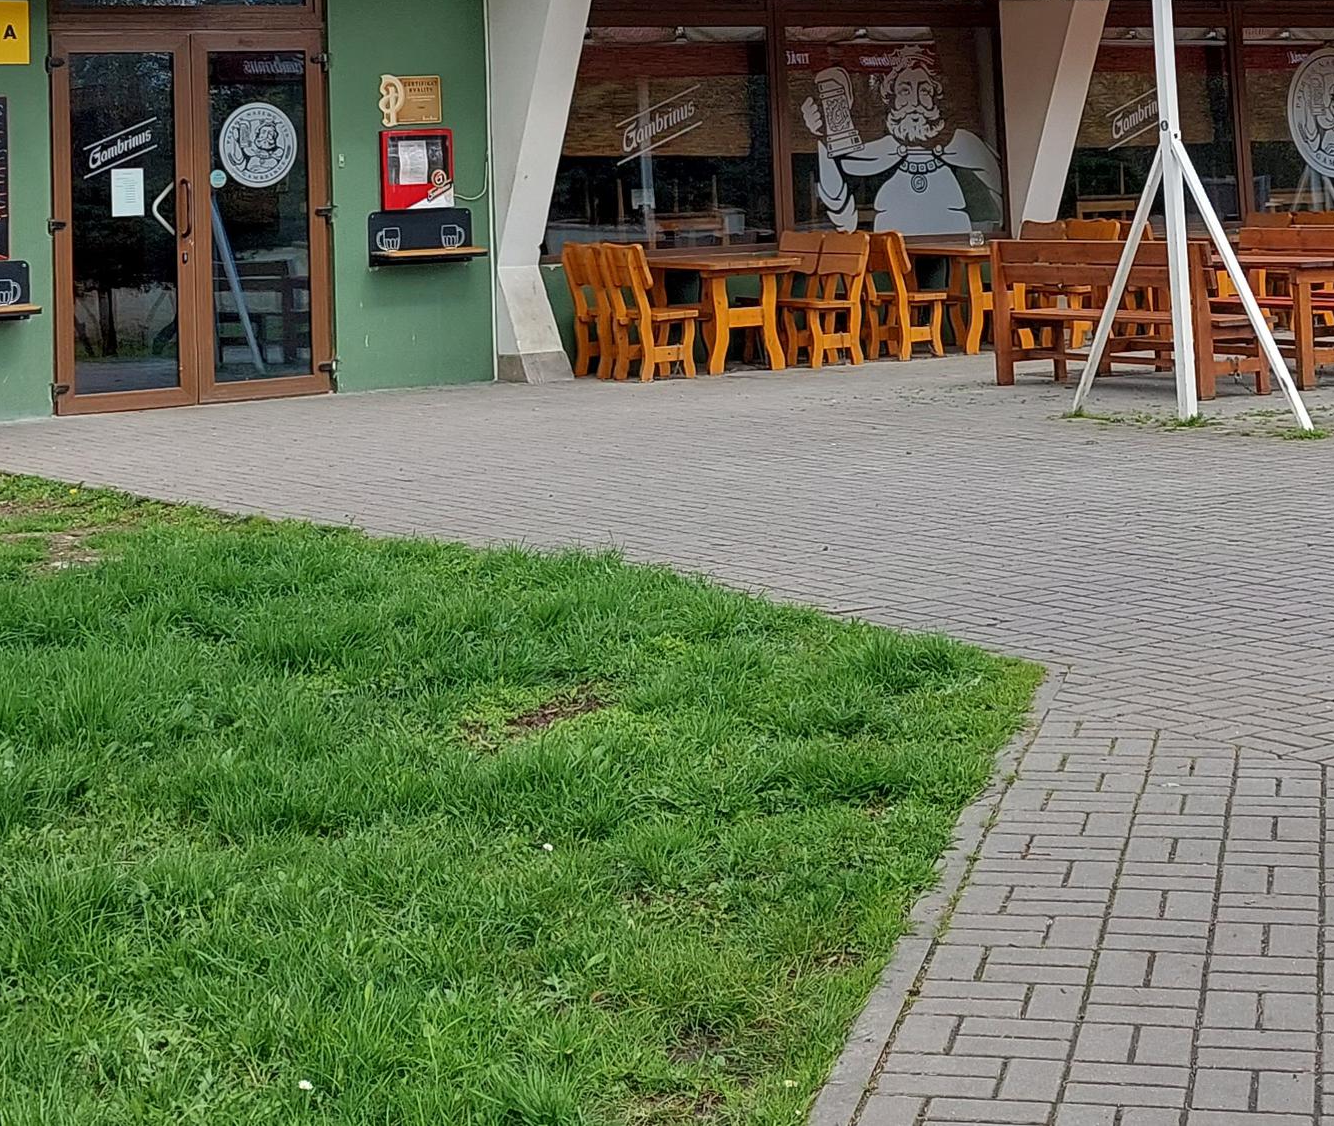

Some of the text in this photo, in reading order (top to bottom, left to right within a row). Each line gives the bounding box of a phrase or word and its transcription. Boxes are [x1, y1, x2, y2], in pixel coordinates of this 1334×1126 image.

[623, 100, 695, 152] Gambrinus
[1112, 100, 1159, 139] Gambrin
[89, 129, 152, 169] Gambrinus
